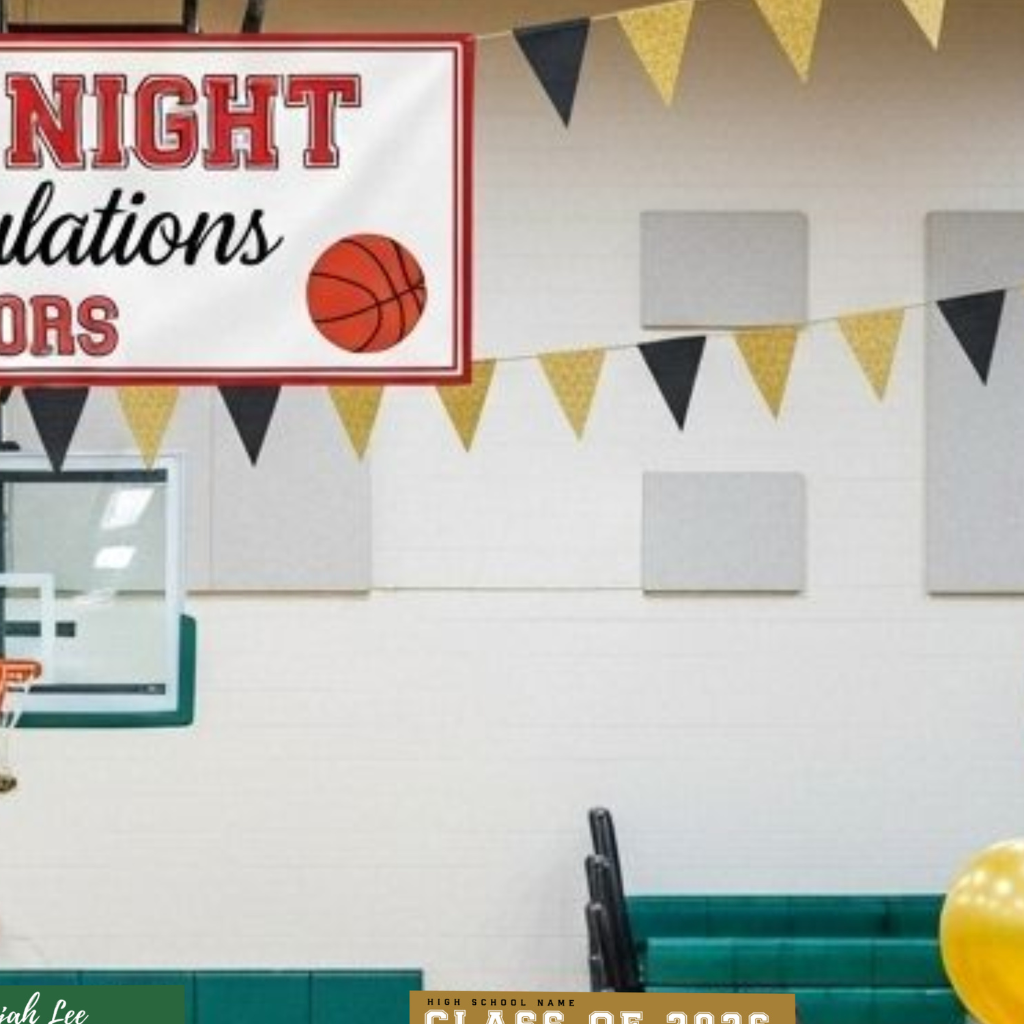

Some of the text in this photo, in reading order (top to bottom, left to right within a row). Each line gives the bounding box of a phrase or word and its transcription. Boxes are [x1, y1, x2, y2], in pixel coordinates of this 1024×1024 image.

[5, 72, 362, 170] NIGHT
[427, 998, 576, 1007] HIGH SCHOOL NAME
